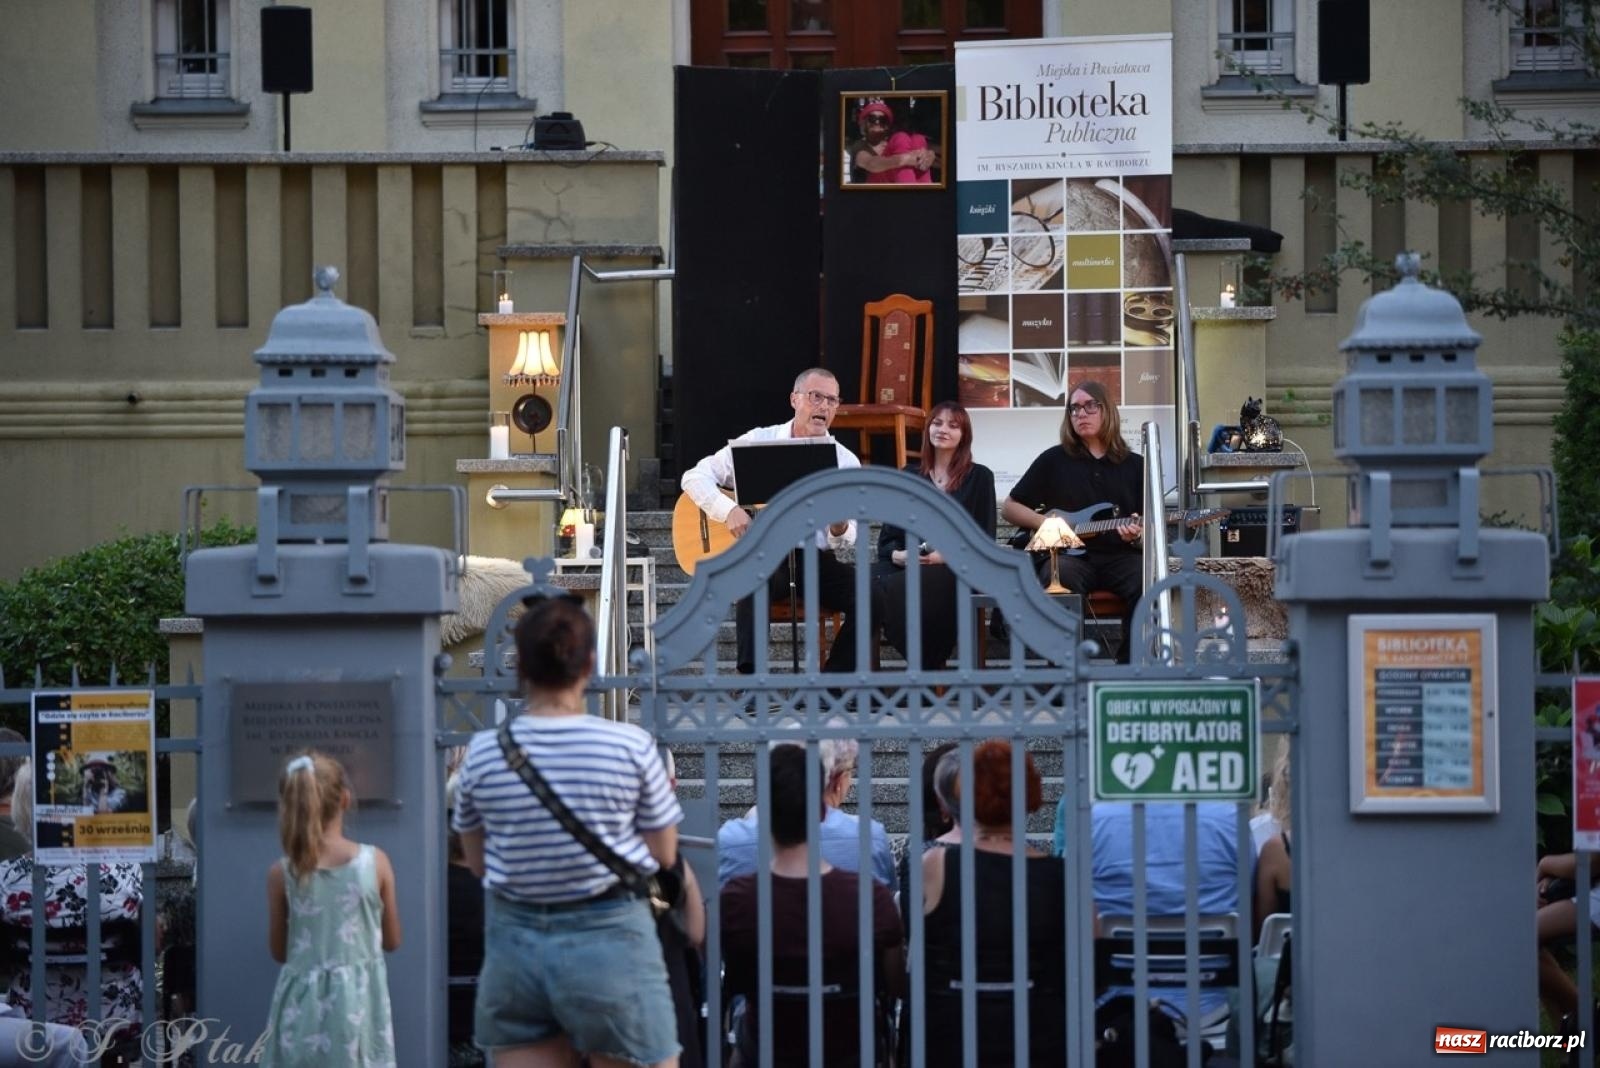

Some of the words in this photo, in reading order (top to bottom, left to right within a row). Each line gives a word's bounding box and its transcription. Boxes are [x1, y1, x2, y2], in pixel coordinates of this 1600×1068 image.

[1036, 63, 1081, 80] Miejska
[1090, 61, 1151, 76] Powiatowa
[977, 80, 1150, 122] Biblioteka
[1044, 121, 1137, 145] Publiczna
[995, 162, 1043, 171] RYSZARDA
[1085, 160, 1093, 169] W
[1097, 158, 1151, 169] RACIBORZU
[1377, 637, 1468, 653] BIBLIOTEKA
[1106, 699, 1147, 716] OBIEKT
[1150, 697, 1227, 716] WYPOSAŻONY
[1230, 698, 1242, 715] W
[1106, 721, 1243, 743] DEFIBRYLATOR
[1171, 752, 1245, 791] AED
[79, 825, 93, 835] 30
[96, 823, 151, 835] września
